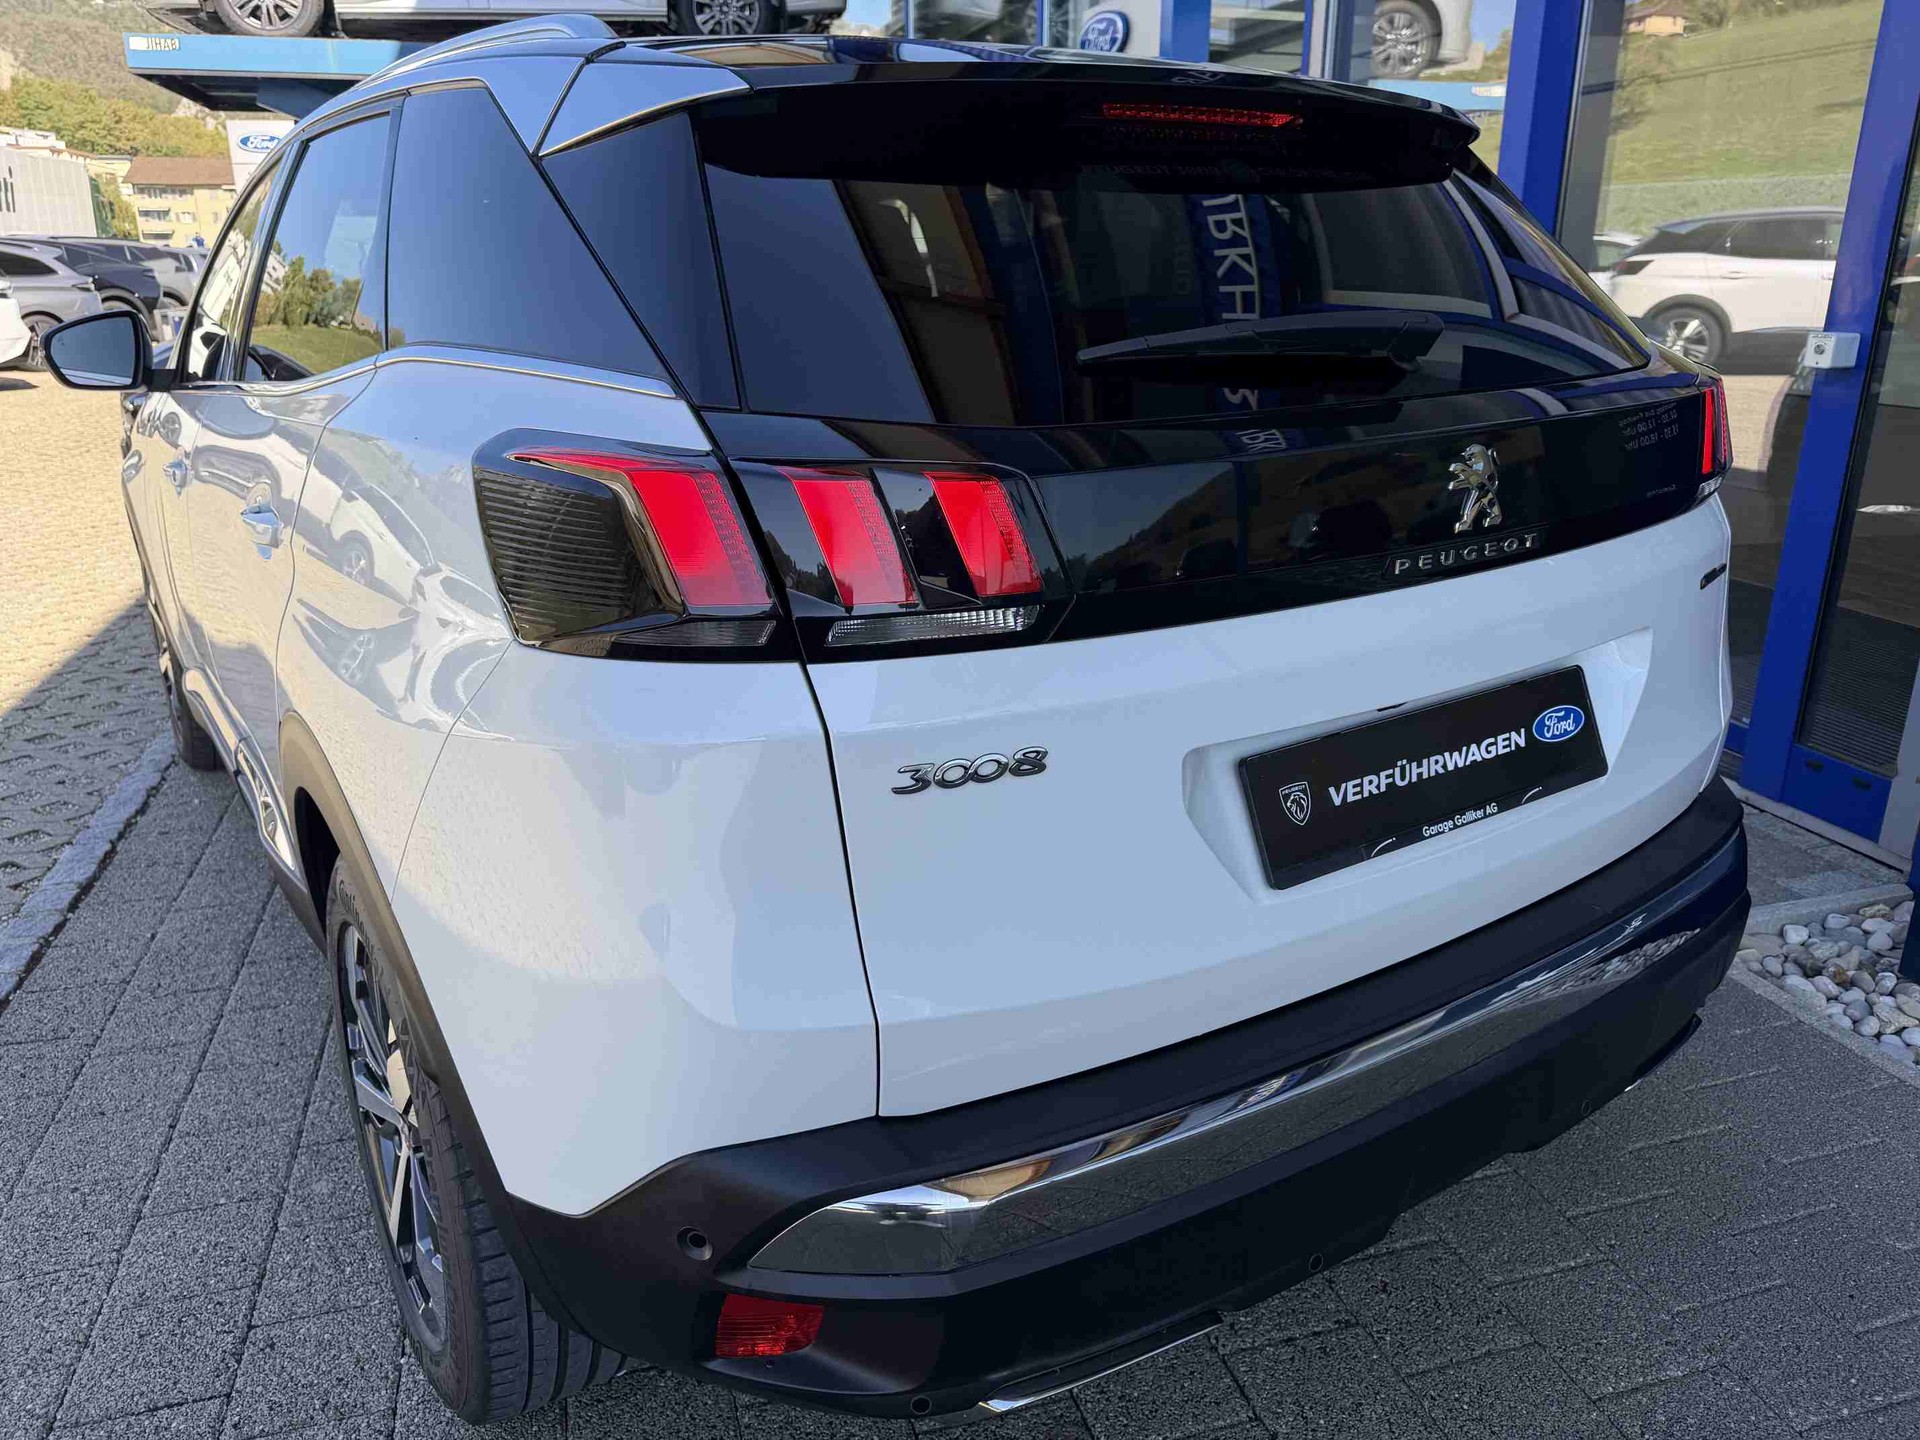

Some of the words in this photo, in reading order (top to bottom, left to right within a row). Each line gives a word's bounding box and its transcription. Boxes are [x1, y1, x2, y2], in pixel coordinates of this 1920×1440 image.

[1394, 532, 1538, 575] PEUGEOT
[891, 746, 1049, 795] 3008
[1328, 729, 1526, 806] VERFÜHRWAGEN
[1281, 784, 1305, 795] PEUGEOT
[1422, 820, 1454, 837] Garage
[1454, 808, 1485, 825] Galliker
[1485, 802, 1498, 816] AG
